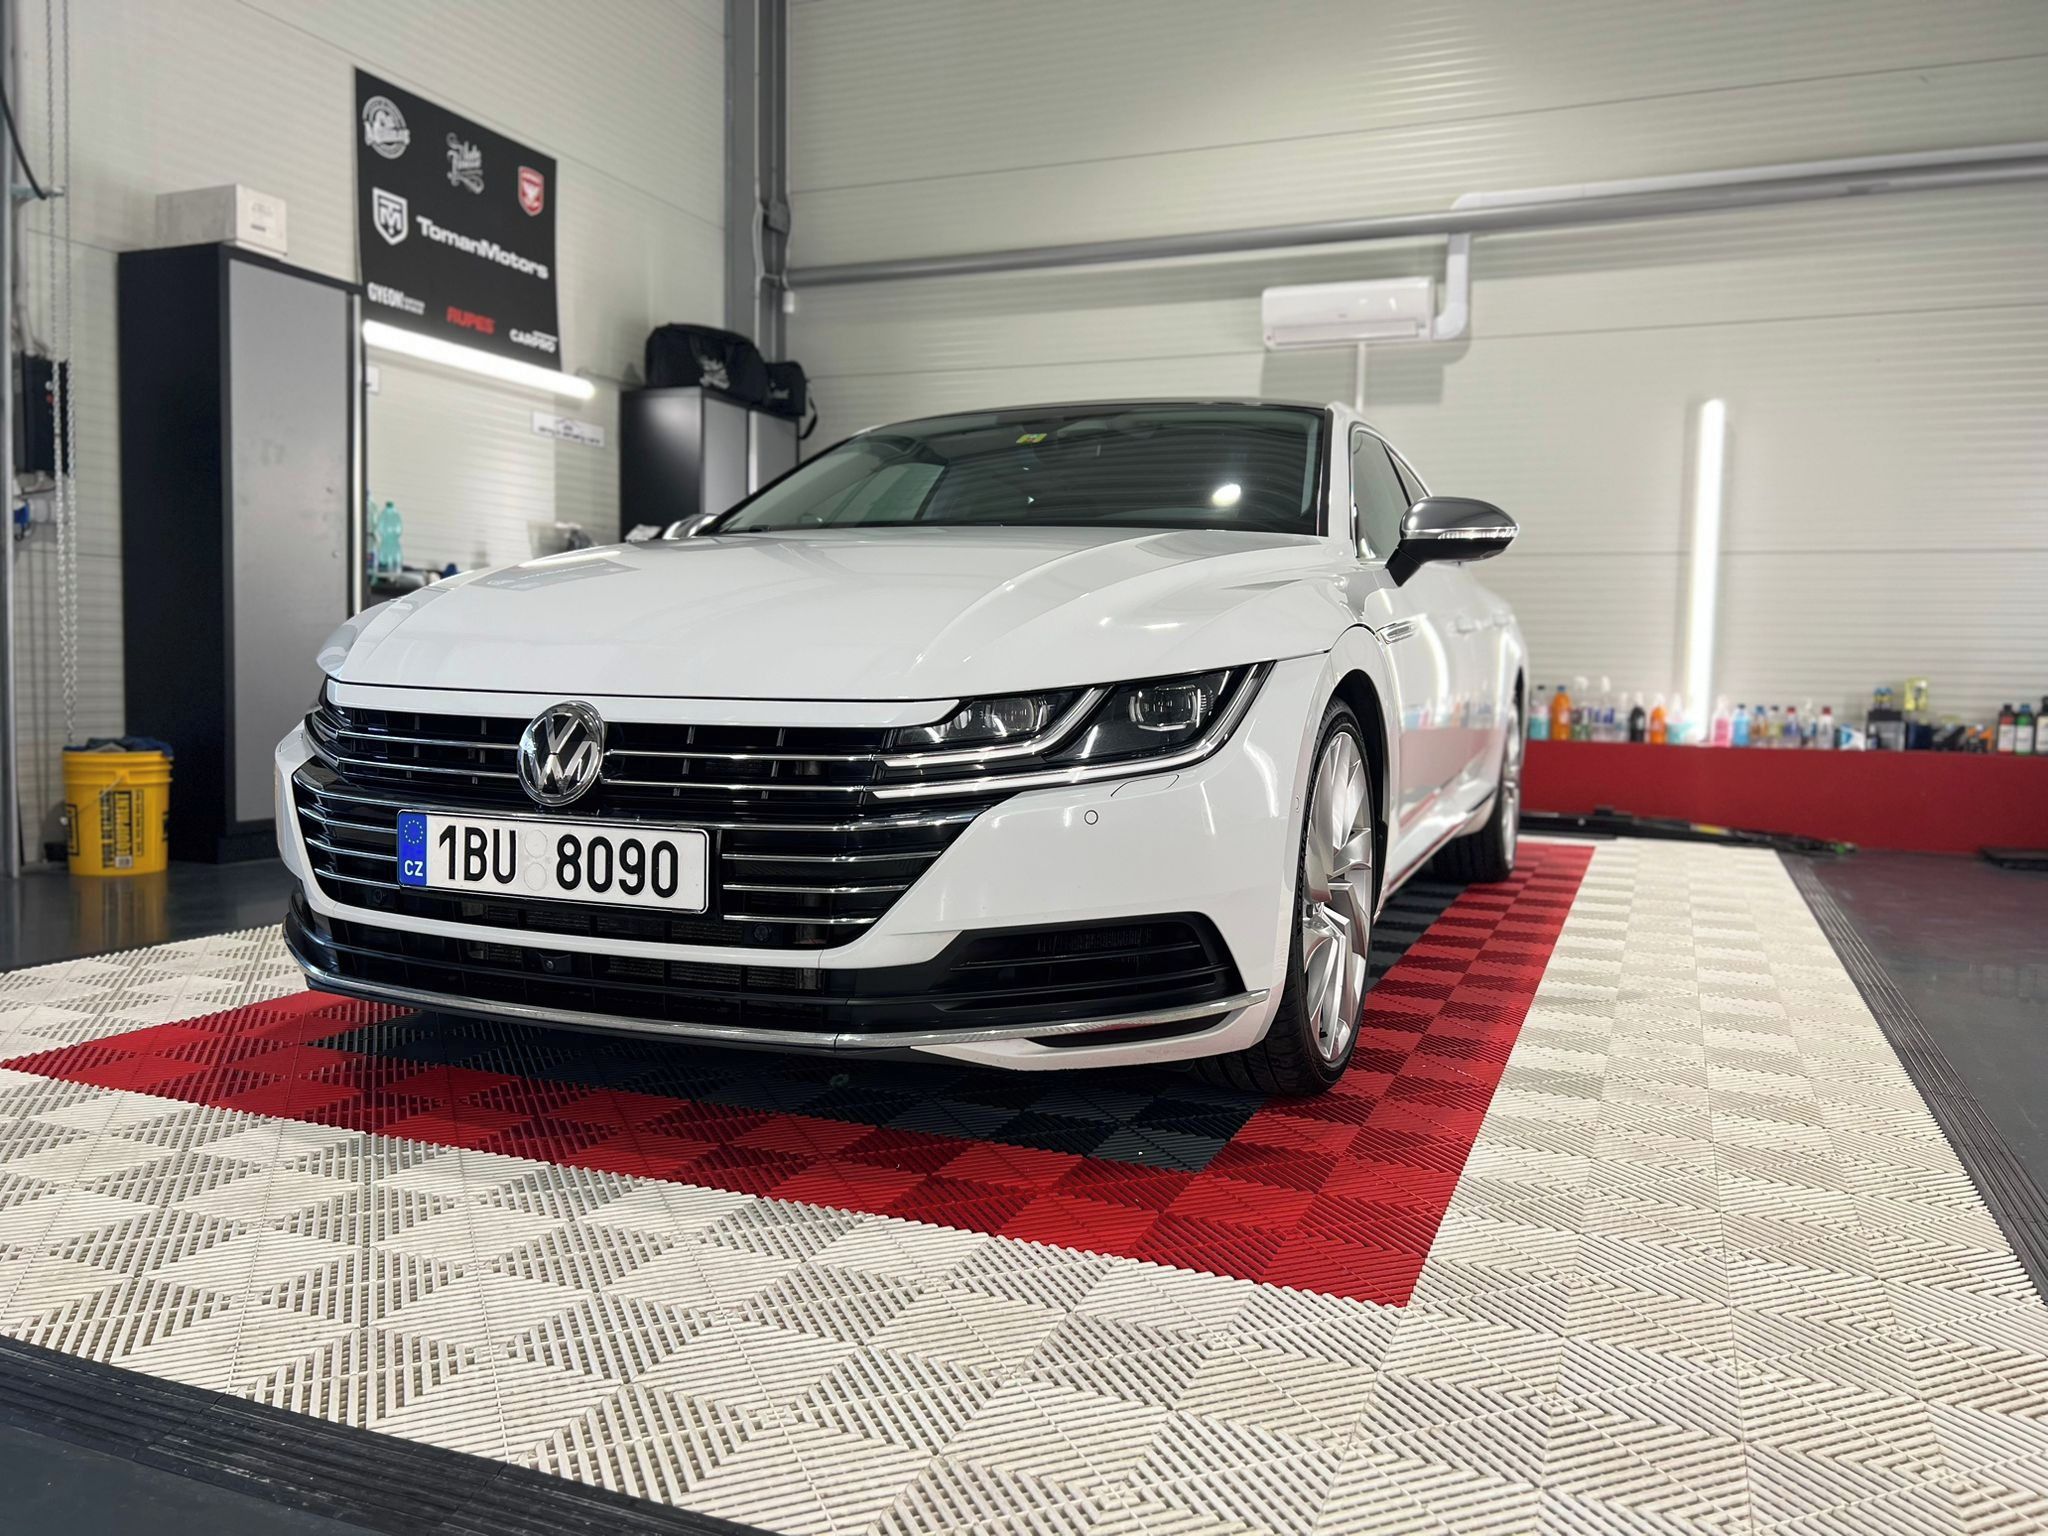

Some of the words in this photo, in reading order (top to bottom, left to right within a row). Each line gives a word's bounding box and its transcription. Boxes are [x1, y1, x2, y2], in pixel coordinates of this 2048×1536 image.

[416, 215, 549, 280] TomanMotors
[404, 860, 424, 877] CZ
[439, 825, 517, 884] 1BU
[556, 834, 680, 898] 8090
